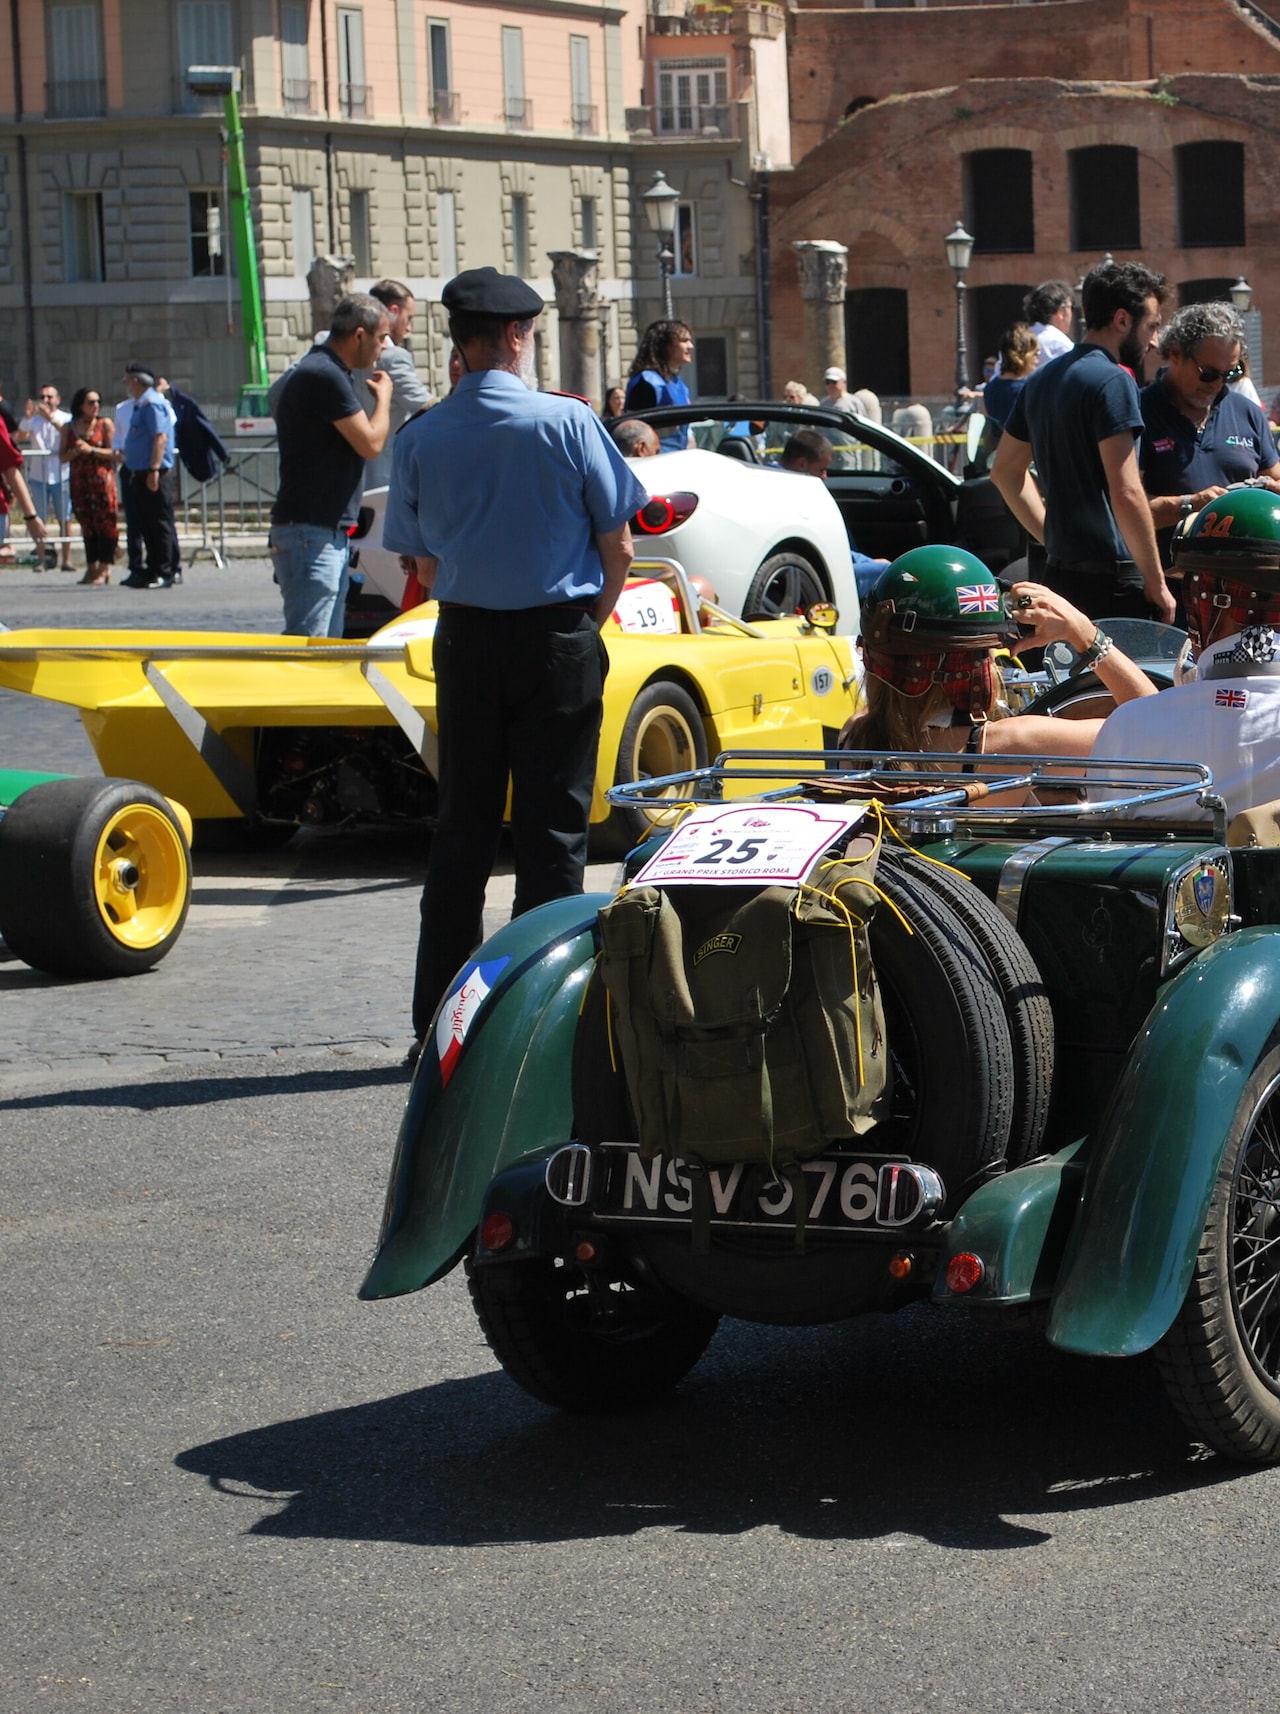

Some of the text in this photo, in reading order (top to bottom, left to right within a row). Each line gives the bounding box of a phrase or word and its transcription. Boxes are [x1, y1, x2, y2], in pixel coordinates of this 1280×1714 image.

[1197, 512, 1234, 537] 34
[637, 607, 657, 628] 19
[814, 672, 828, 690] 157
[692, 838, 768, 864] 25
[697, 936, 735, 959] SINGER
